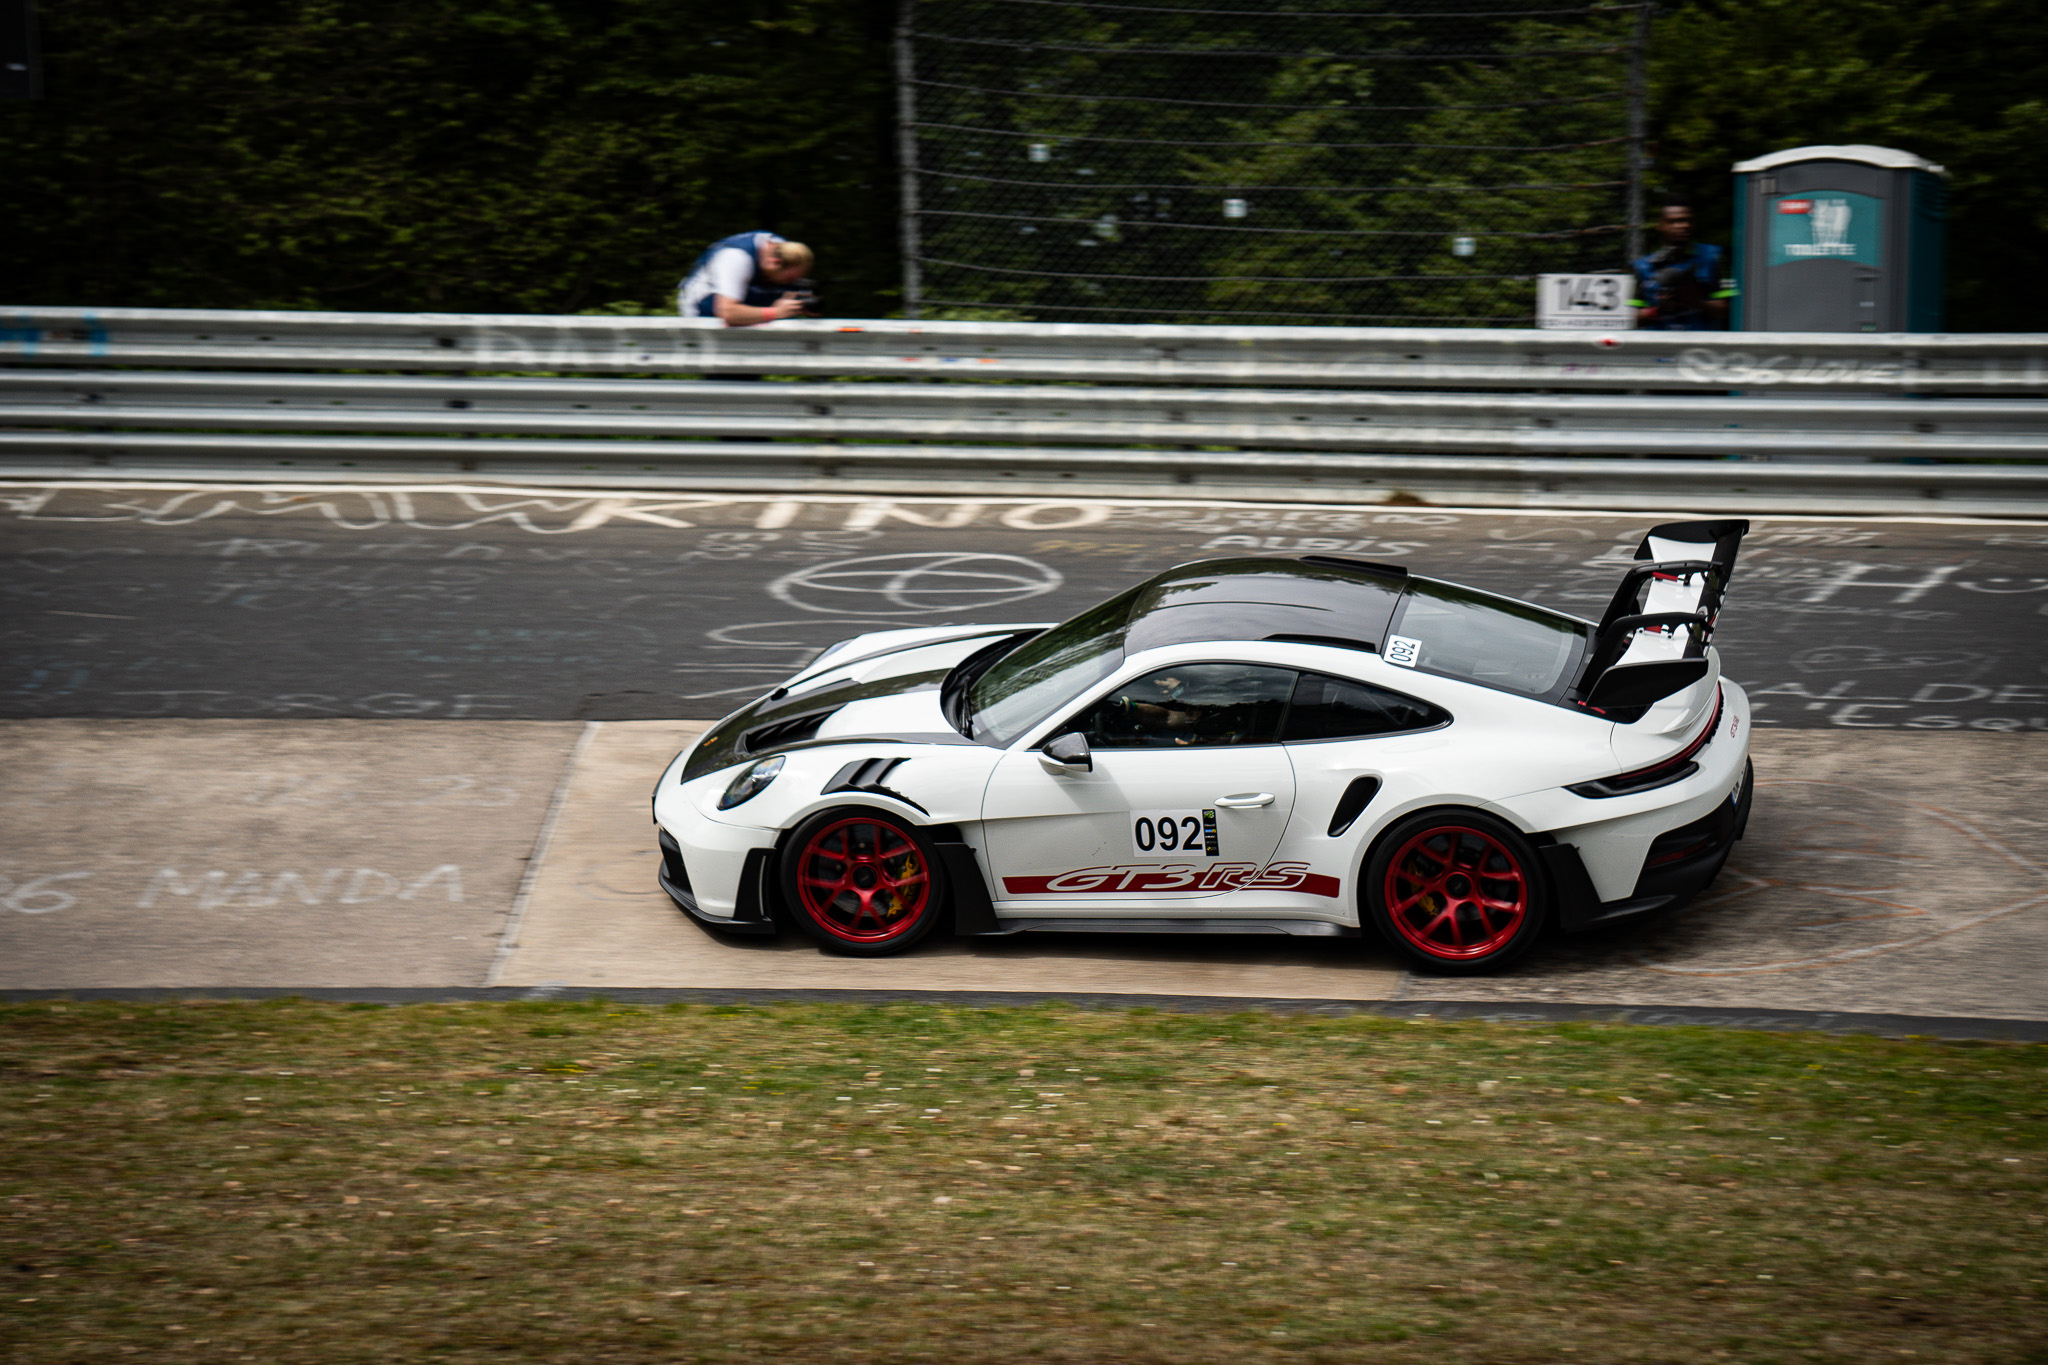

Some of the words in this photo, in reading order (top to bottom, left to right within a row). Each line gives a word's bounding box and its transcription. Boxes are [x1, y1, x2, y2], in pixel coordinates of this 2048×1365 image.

[1556, 278, 1621, 311] 143
[1389, 640, 1416, 662] 092
[1134, 816, 1204, 852] 092
